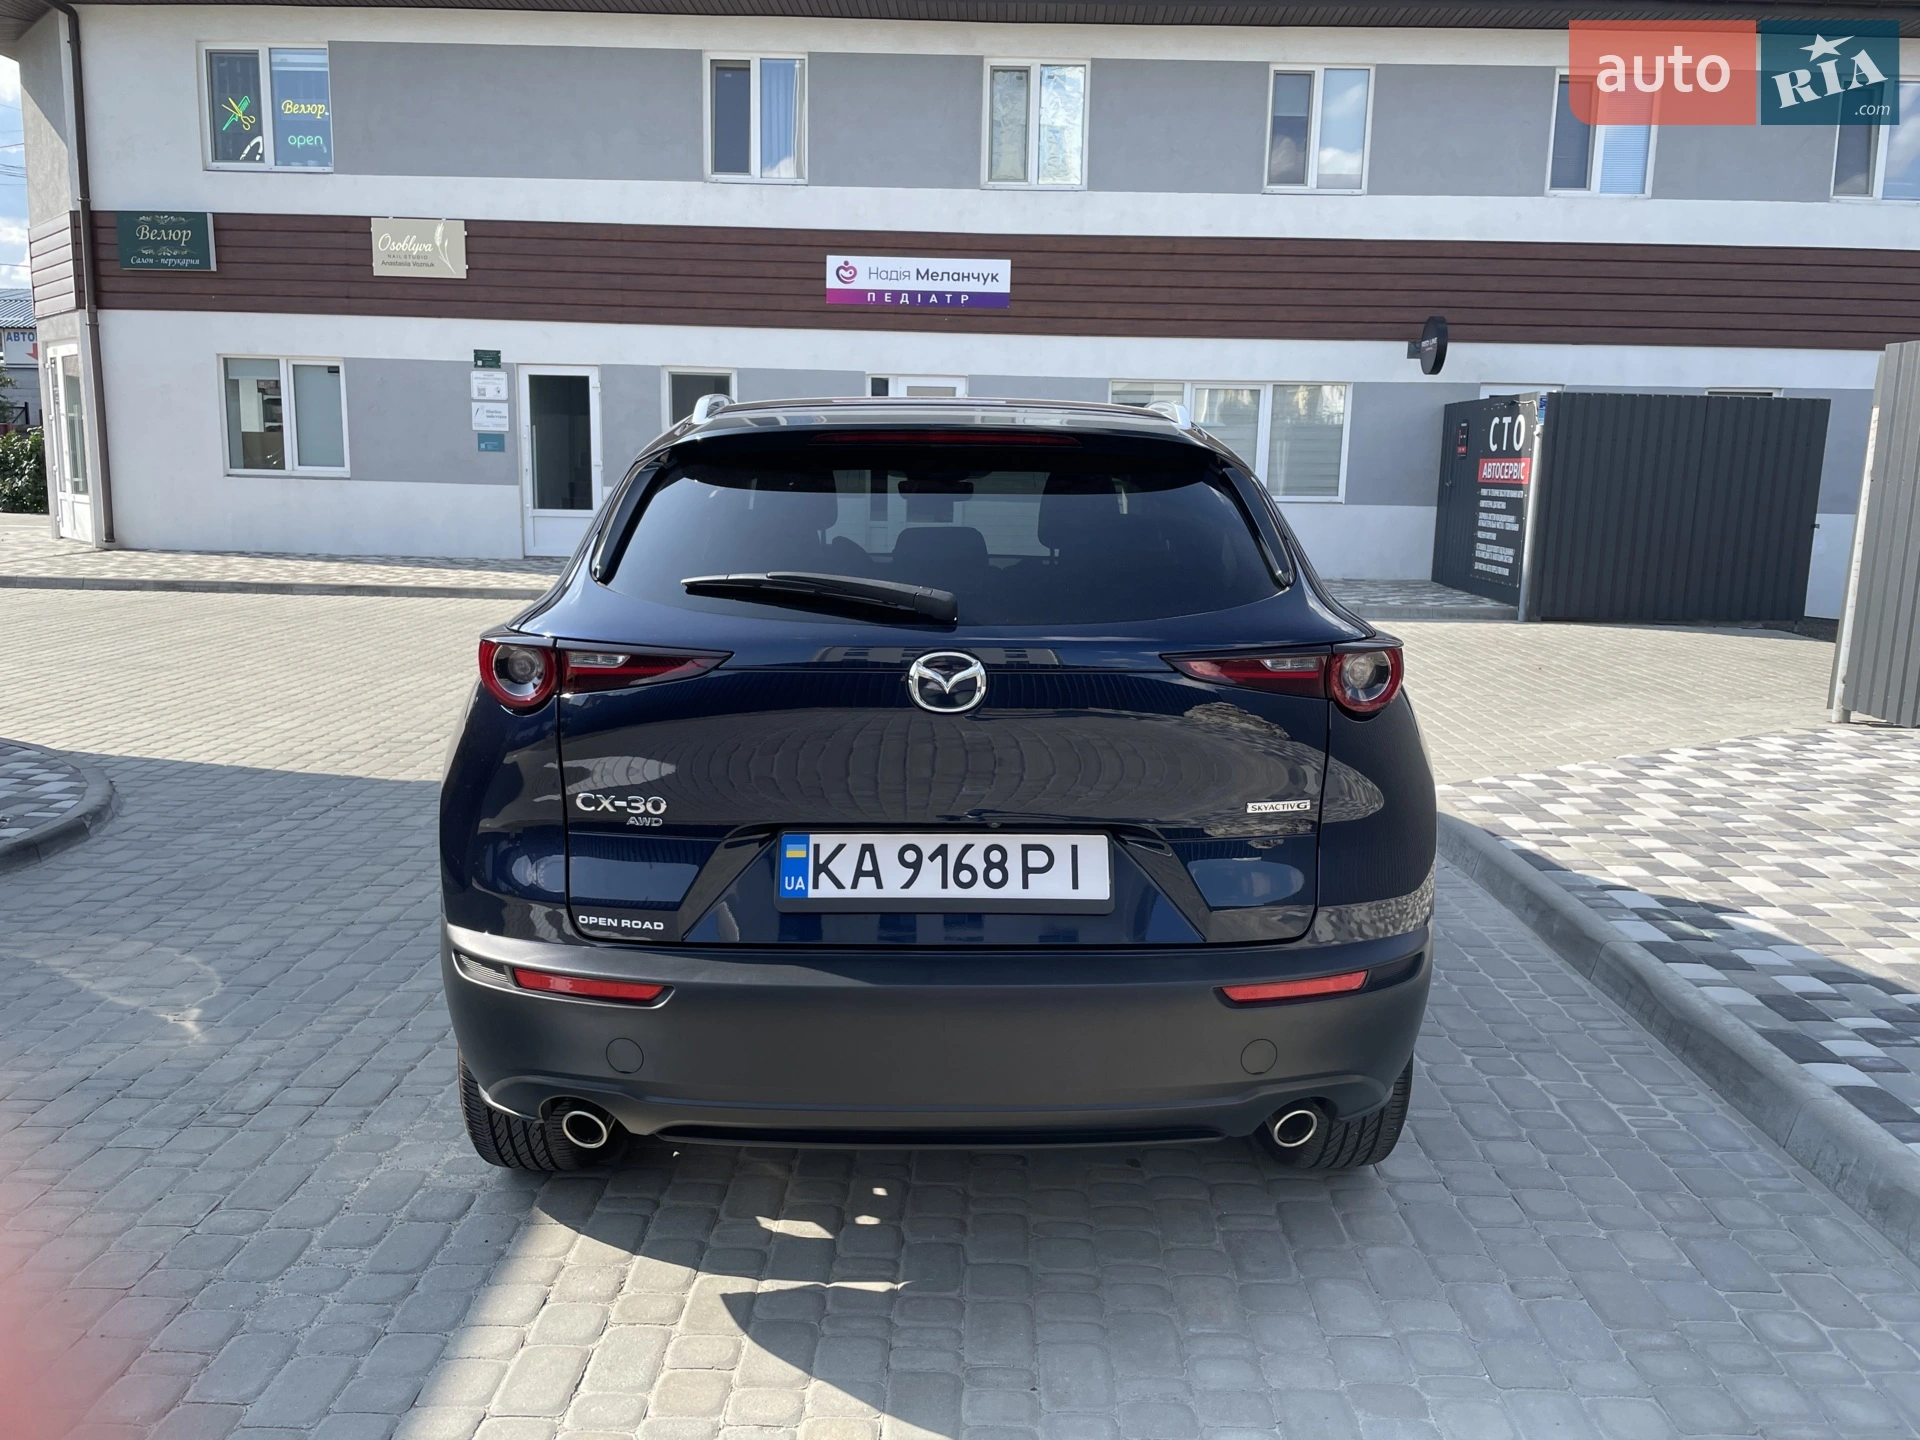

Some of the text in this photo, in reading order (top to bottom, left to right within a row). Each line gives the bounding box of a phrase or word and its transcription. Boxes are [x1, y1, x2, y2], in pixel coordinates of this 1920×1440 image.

[281, 99, 326, 119] Велюр
[287, 135, 323, 149] open
[135, 224, 192, 247] Велюр
[378, 232, 434, 256] Osoblyva
[130, 255, 154, 265] Салон
[160, 257, 200, 268] перукарня
[868, 266, 1000, 286] Надія Меланчук
[867, 291, 969, 305] ПЕДІАТР
[6, 331, 38, 342] АВТО
[1489, 413, 1526, 452] СТО
[1481, 462, 1526, 480] АВТОСЕРВІС
[575, 792, 668, 815] CX-30
[625, 816, 663, 827] AWD
[812, 843, 884, 890] KA
[897, 843, 1009, 890] 9168
[784, 875, 806, 891] UA
[578, 915, 665, 931] OPEN ROAD
